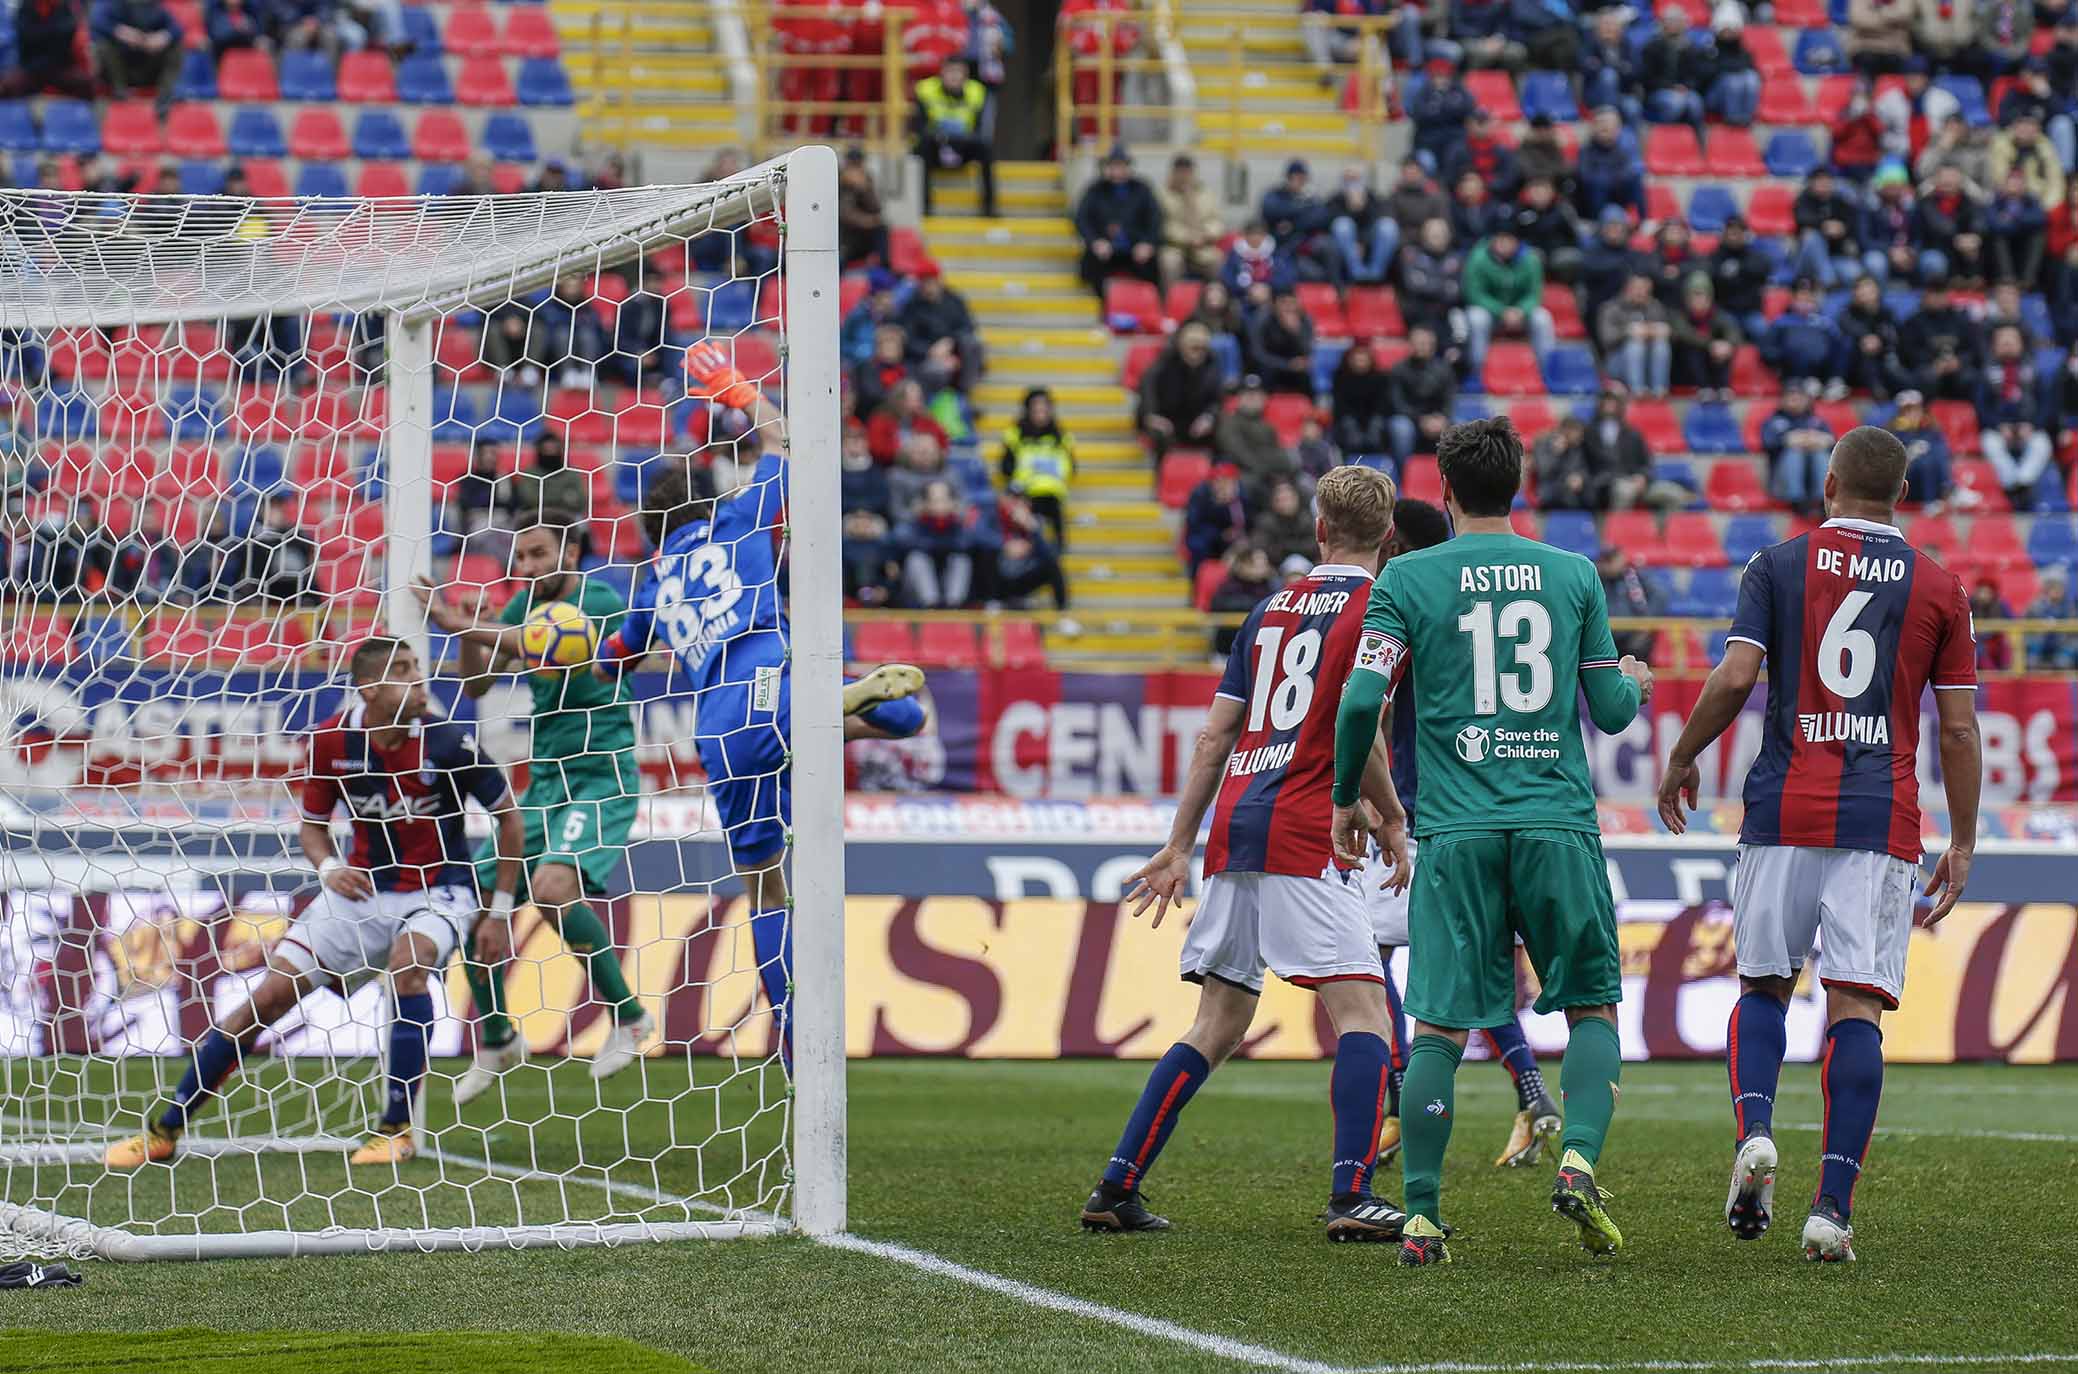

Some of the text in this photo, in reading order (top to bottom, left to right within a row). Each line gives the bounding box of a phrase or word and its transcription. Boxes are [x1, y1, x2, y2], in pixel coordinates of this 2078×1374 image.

[1460, 565, 1543, 592] ASTORI
[1816, 548, 1905, 583] DE MAIO
[656, 543, 743, 653] 83
[1264, 590, 1350, 616] HELANDER
[1458, 600, 1554, 715] 13
[1817, 590, 1877, 698] 6
[1248, 626, 1323, 732] 18
[1494, 728, 1560, 742] Save the
[1798, 711, 1889, 744] ILLUMIA
[1230, 741, 1297, 777] ILLUMIA
[1494, 745, 1560, 759] Children
